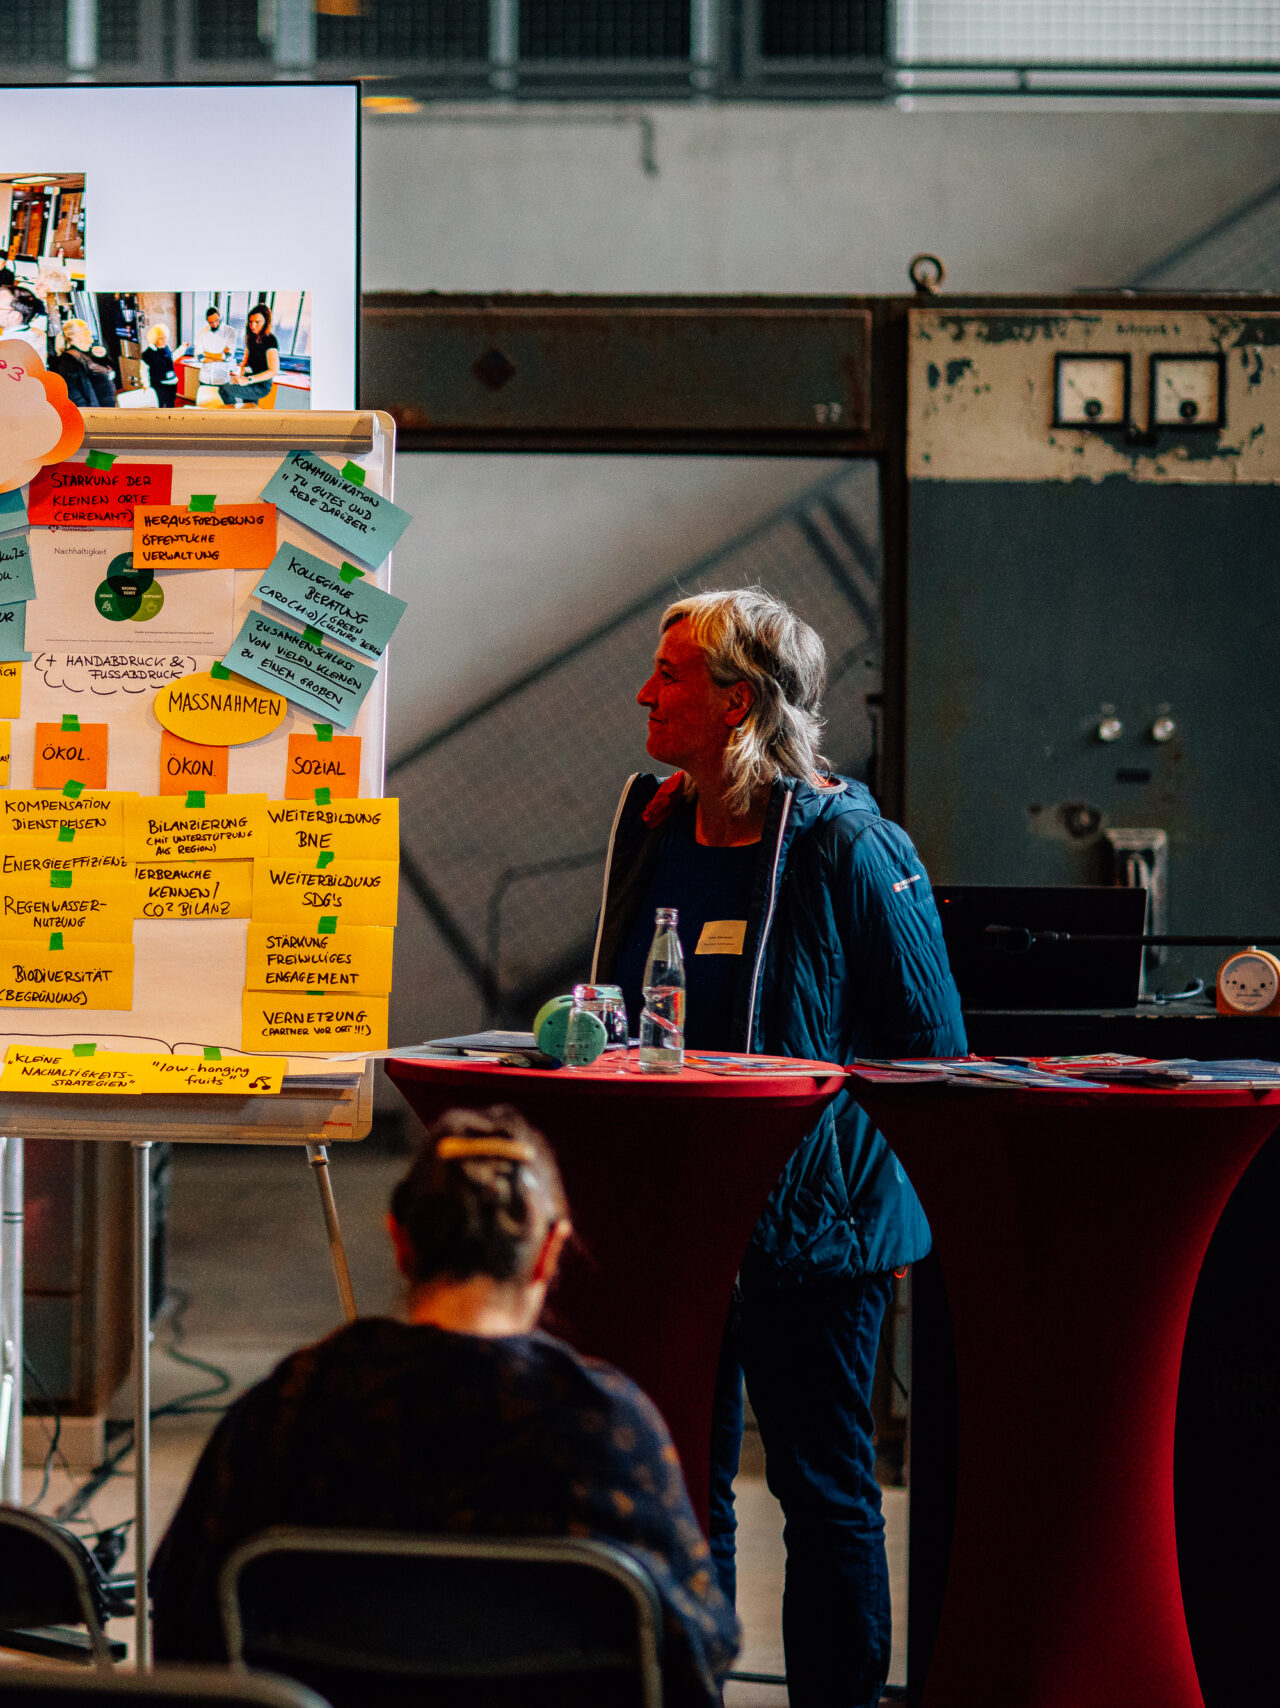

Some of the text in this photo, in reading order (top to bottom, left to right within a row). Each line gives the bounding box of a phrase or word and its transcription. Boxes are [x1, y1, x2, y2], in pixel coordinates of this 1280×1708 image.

[7, 366, 25, 382] 3
[126, 475, 152, 487] DER
[118, 494, 151, 504] ORTE
[290, 485, 316, 506] REDE
[312, 485, 345, 508] GUTES
[349, 503, 372, 521] UND
[142, 533, 216, 546] ÖFFENTLICHE
[54, 547, 107, 557] Nachhaltigkeit
[142, 550, 221, 562] VERWALTUNG
[304, 586, 368, 624] BERATUNG
[320, 620, 358, 643] CULTURE
[329, 615, 363, 635] GREEN
[249, 633, 271, 650] VON
[255, 619, 356, 671] ZUSAMMENSCHLUSS
[240, 648, 254, 660] ZU
[66, 656, 167, 668] HANDABDRUCK
[88, 669, 184, 680] FUSSABDRUCK
[168, 691, 281, 717] MASSNAHMEN
[42, 743, 91, 762] ÖKOL.
[167, 753, 217, 778] ÖKON.
[295, 830, 333, 849] BNE
[4, 895, 108, 916] REGENWASSER-
[33, 916, 86, 928] NUTZUNG
[265, 934, 329, 949] STÄRKUNG
[265, 971, 360, 985] ENGAGEMENT
[263, 1010, 368, 1025] VERNETZUNG
[314, 1026, 332, 1034] VOR
